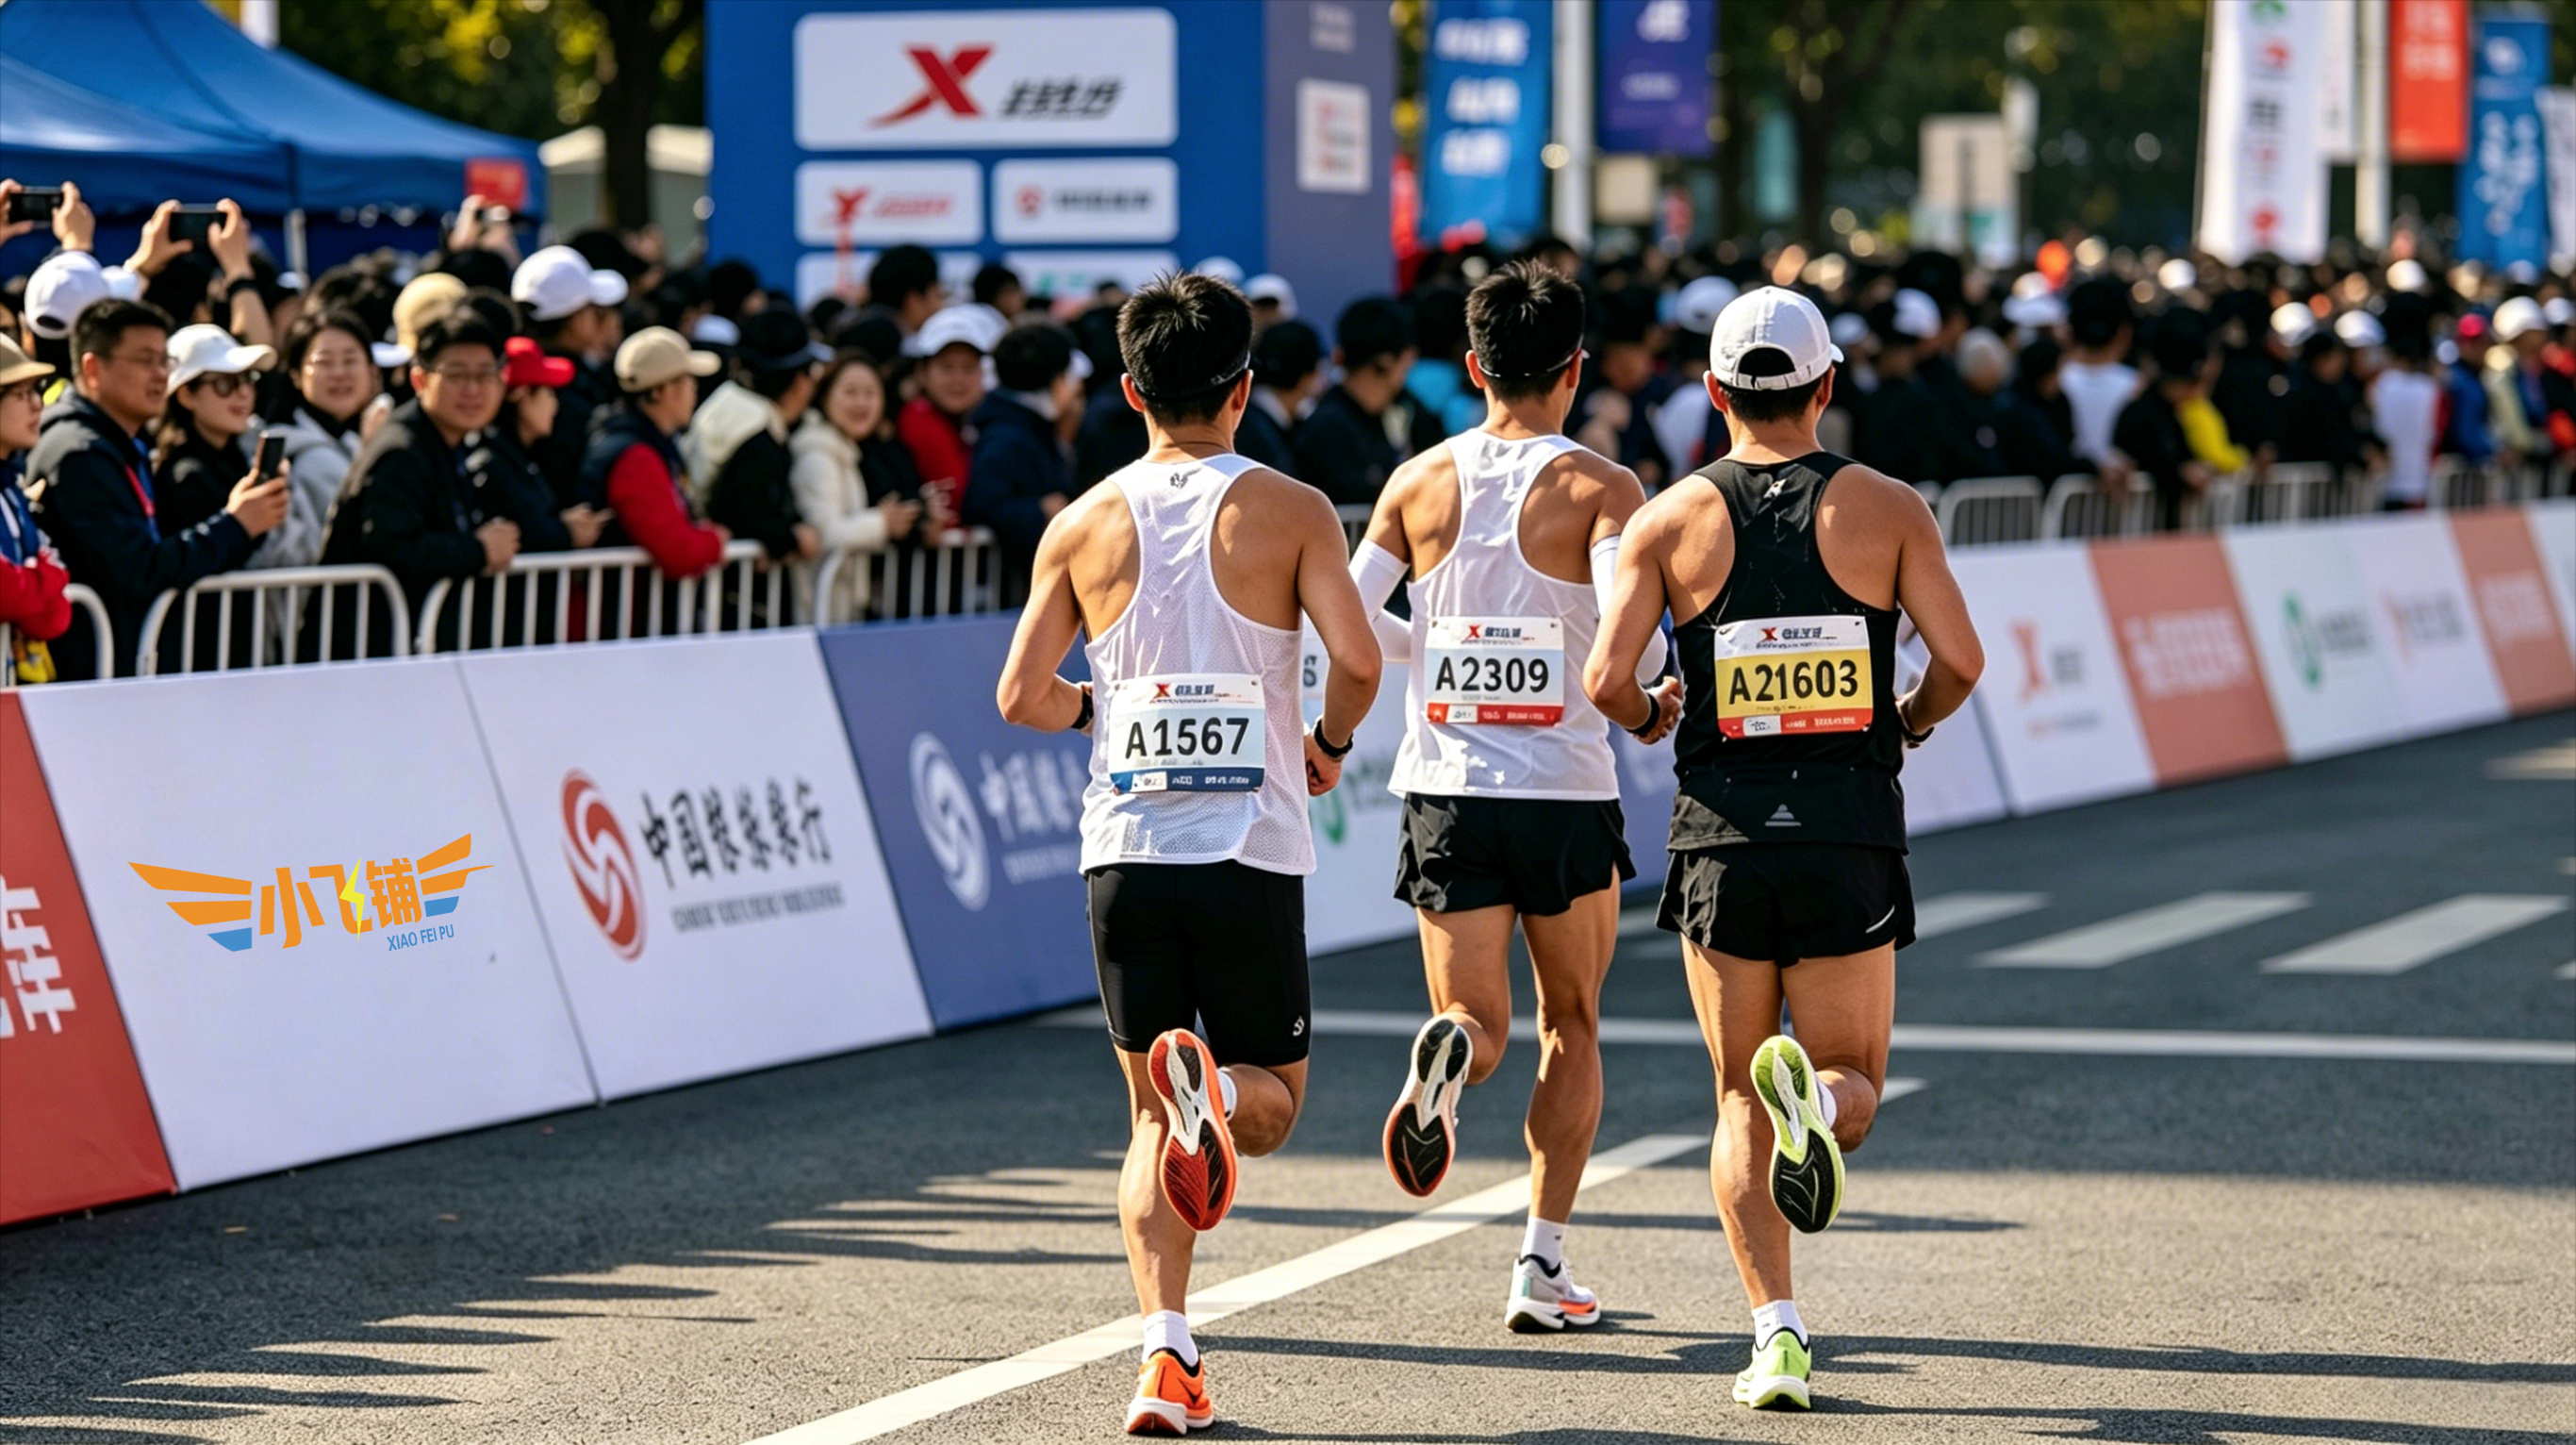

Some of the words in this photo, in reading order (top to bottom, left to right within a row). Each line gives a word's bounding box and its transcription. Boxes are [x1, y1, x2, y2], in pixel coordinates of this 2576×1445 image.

[1435, 656, 1549, 693] A2309
[1729, 659, 1858, 705] A21603
[1125, 717, 1250, 759] A1567
[259, 856, 422, 949] 小飞铺
[387, 932, 418, 952] XIAO
[420, 927, 438, 944] FEI
[438, 923, 454, 940] PU
